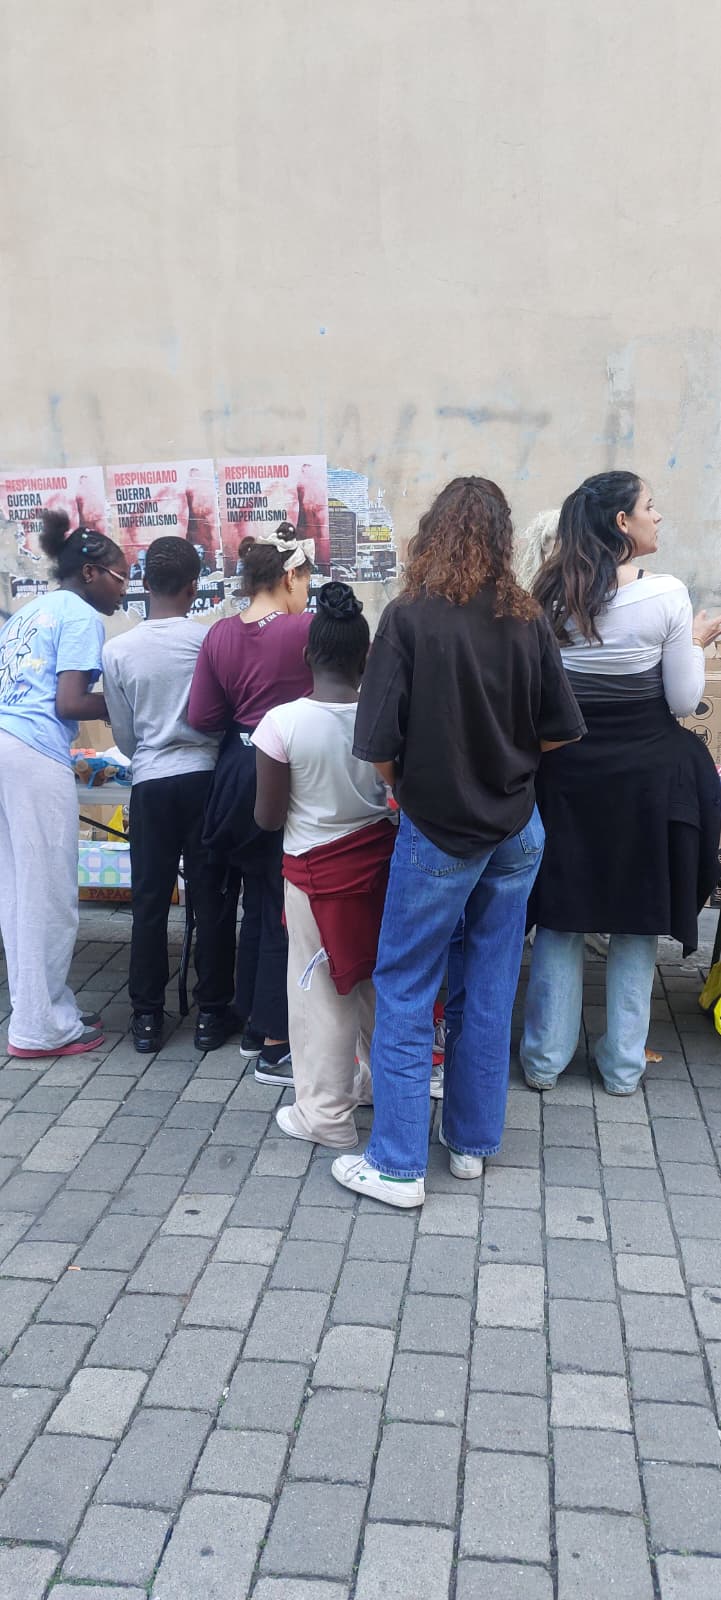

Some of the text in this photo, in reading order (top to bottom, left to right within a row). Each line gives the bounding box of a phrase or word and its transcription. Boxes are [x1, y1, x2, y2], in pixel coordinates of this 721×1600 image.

[114, 470, 177, 486] RESPINGIAMO
[225, 464, 289, 479] RESPINGIAMO
[5, 477, 67, 491] RESPINGIAMO
[226, 482, 262, 495] GUERRA
[7, 494, 42, 507] GUERRA
[116, 487, 151, 501] GUERRA
[117, 502, 158, 515] RAZZISMO
[227, 496, 268, 509] RAZZISMO
[119, 514, 177, 528] IMPERIALISMO
[227, 510, 287, 522] IMPERIALISMO
